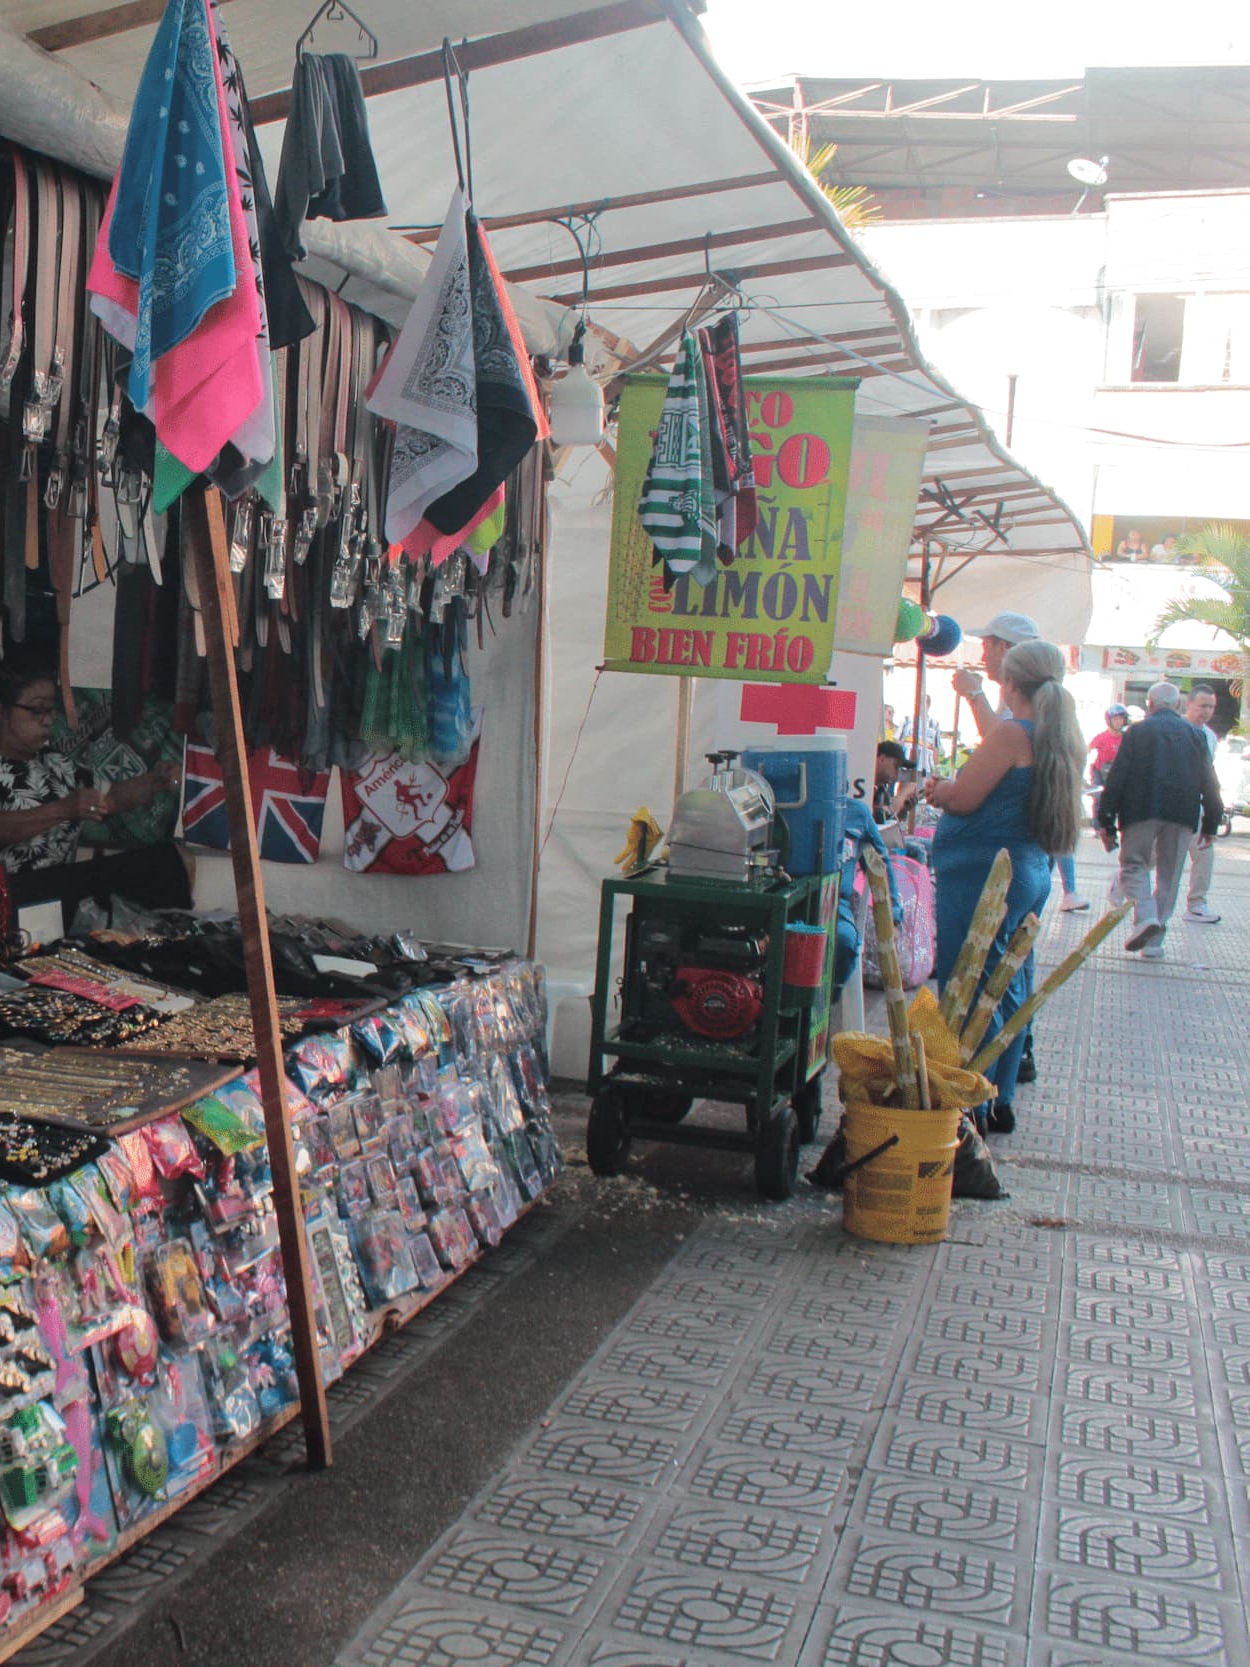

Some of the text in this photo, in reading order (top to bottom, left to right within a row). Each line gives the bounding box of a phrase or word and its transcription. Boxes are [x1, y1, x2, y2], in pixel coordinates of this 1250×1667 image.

[746, 391, 794, 429] CO
[750, 433, 832, 489] GO
[740, 494, 812, 561] ÑA
[670, 562, 834, 623] LIMÓN
[629, 626, 716, 668] BIEN
[722, 627, 815, 673] FRÍO
[363, 756, 404, 799] Améric
